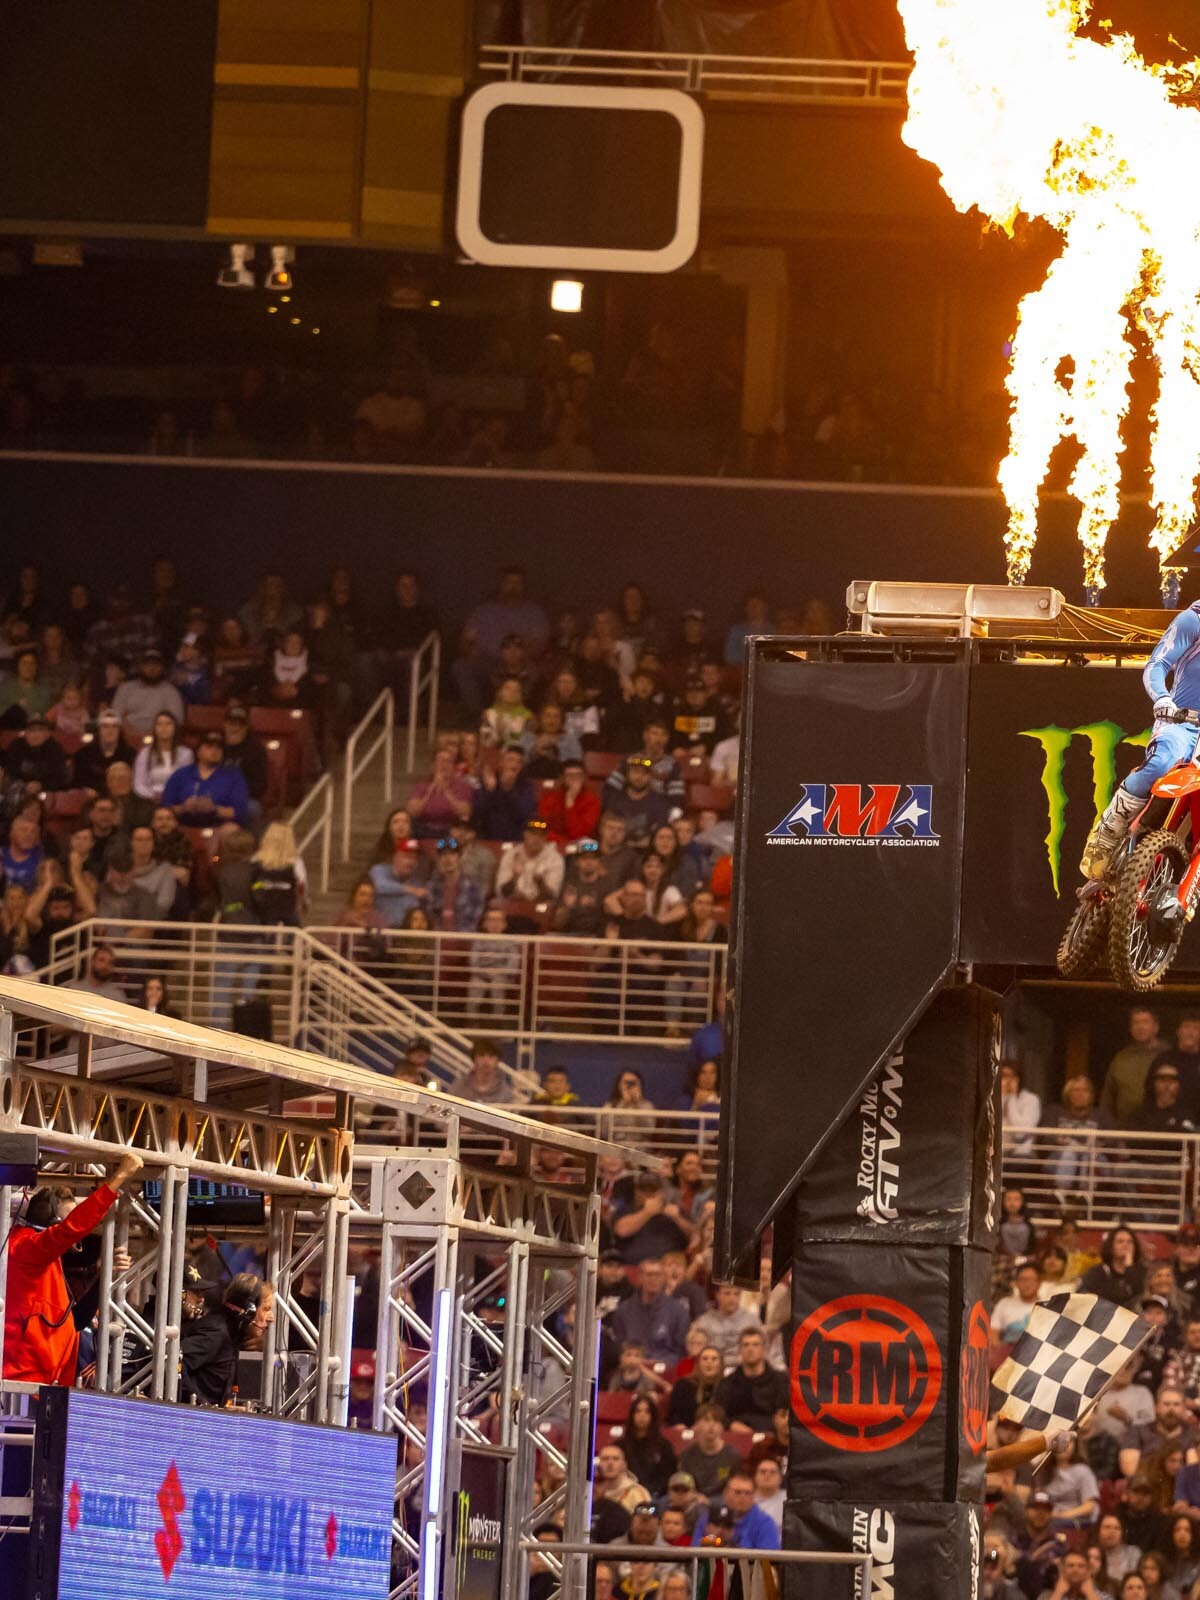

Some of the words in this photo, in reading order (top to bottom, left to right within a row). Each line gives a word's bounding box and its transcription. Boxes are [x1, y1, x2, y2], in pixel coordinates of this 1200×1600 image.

[764, 783, 942, 838] AMA
[766, 837, 813, 846] AMERICAN
[813, 838, 880, 847] MOTORCYCLIST
[881, 839, 940, 847] ASSOCIATION
[857, 1120, 877, 1190] ROCKY
[816, 1340, 910, 1405] RM
[190, 1487, 308, 1575] SUZUKI
[469, 1512, 501, 1545] MONSTER
